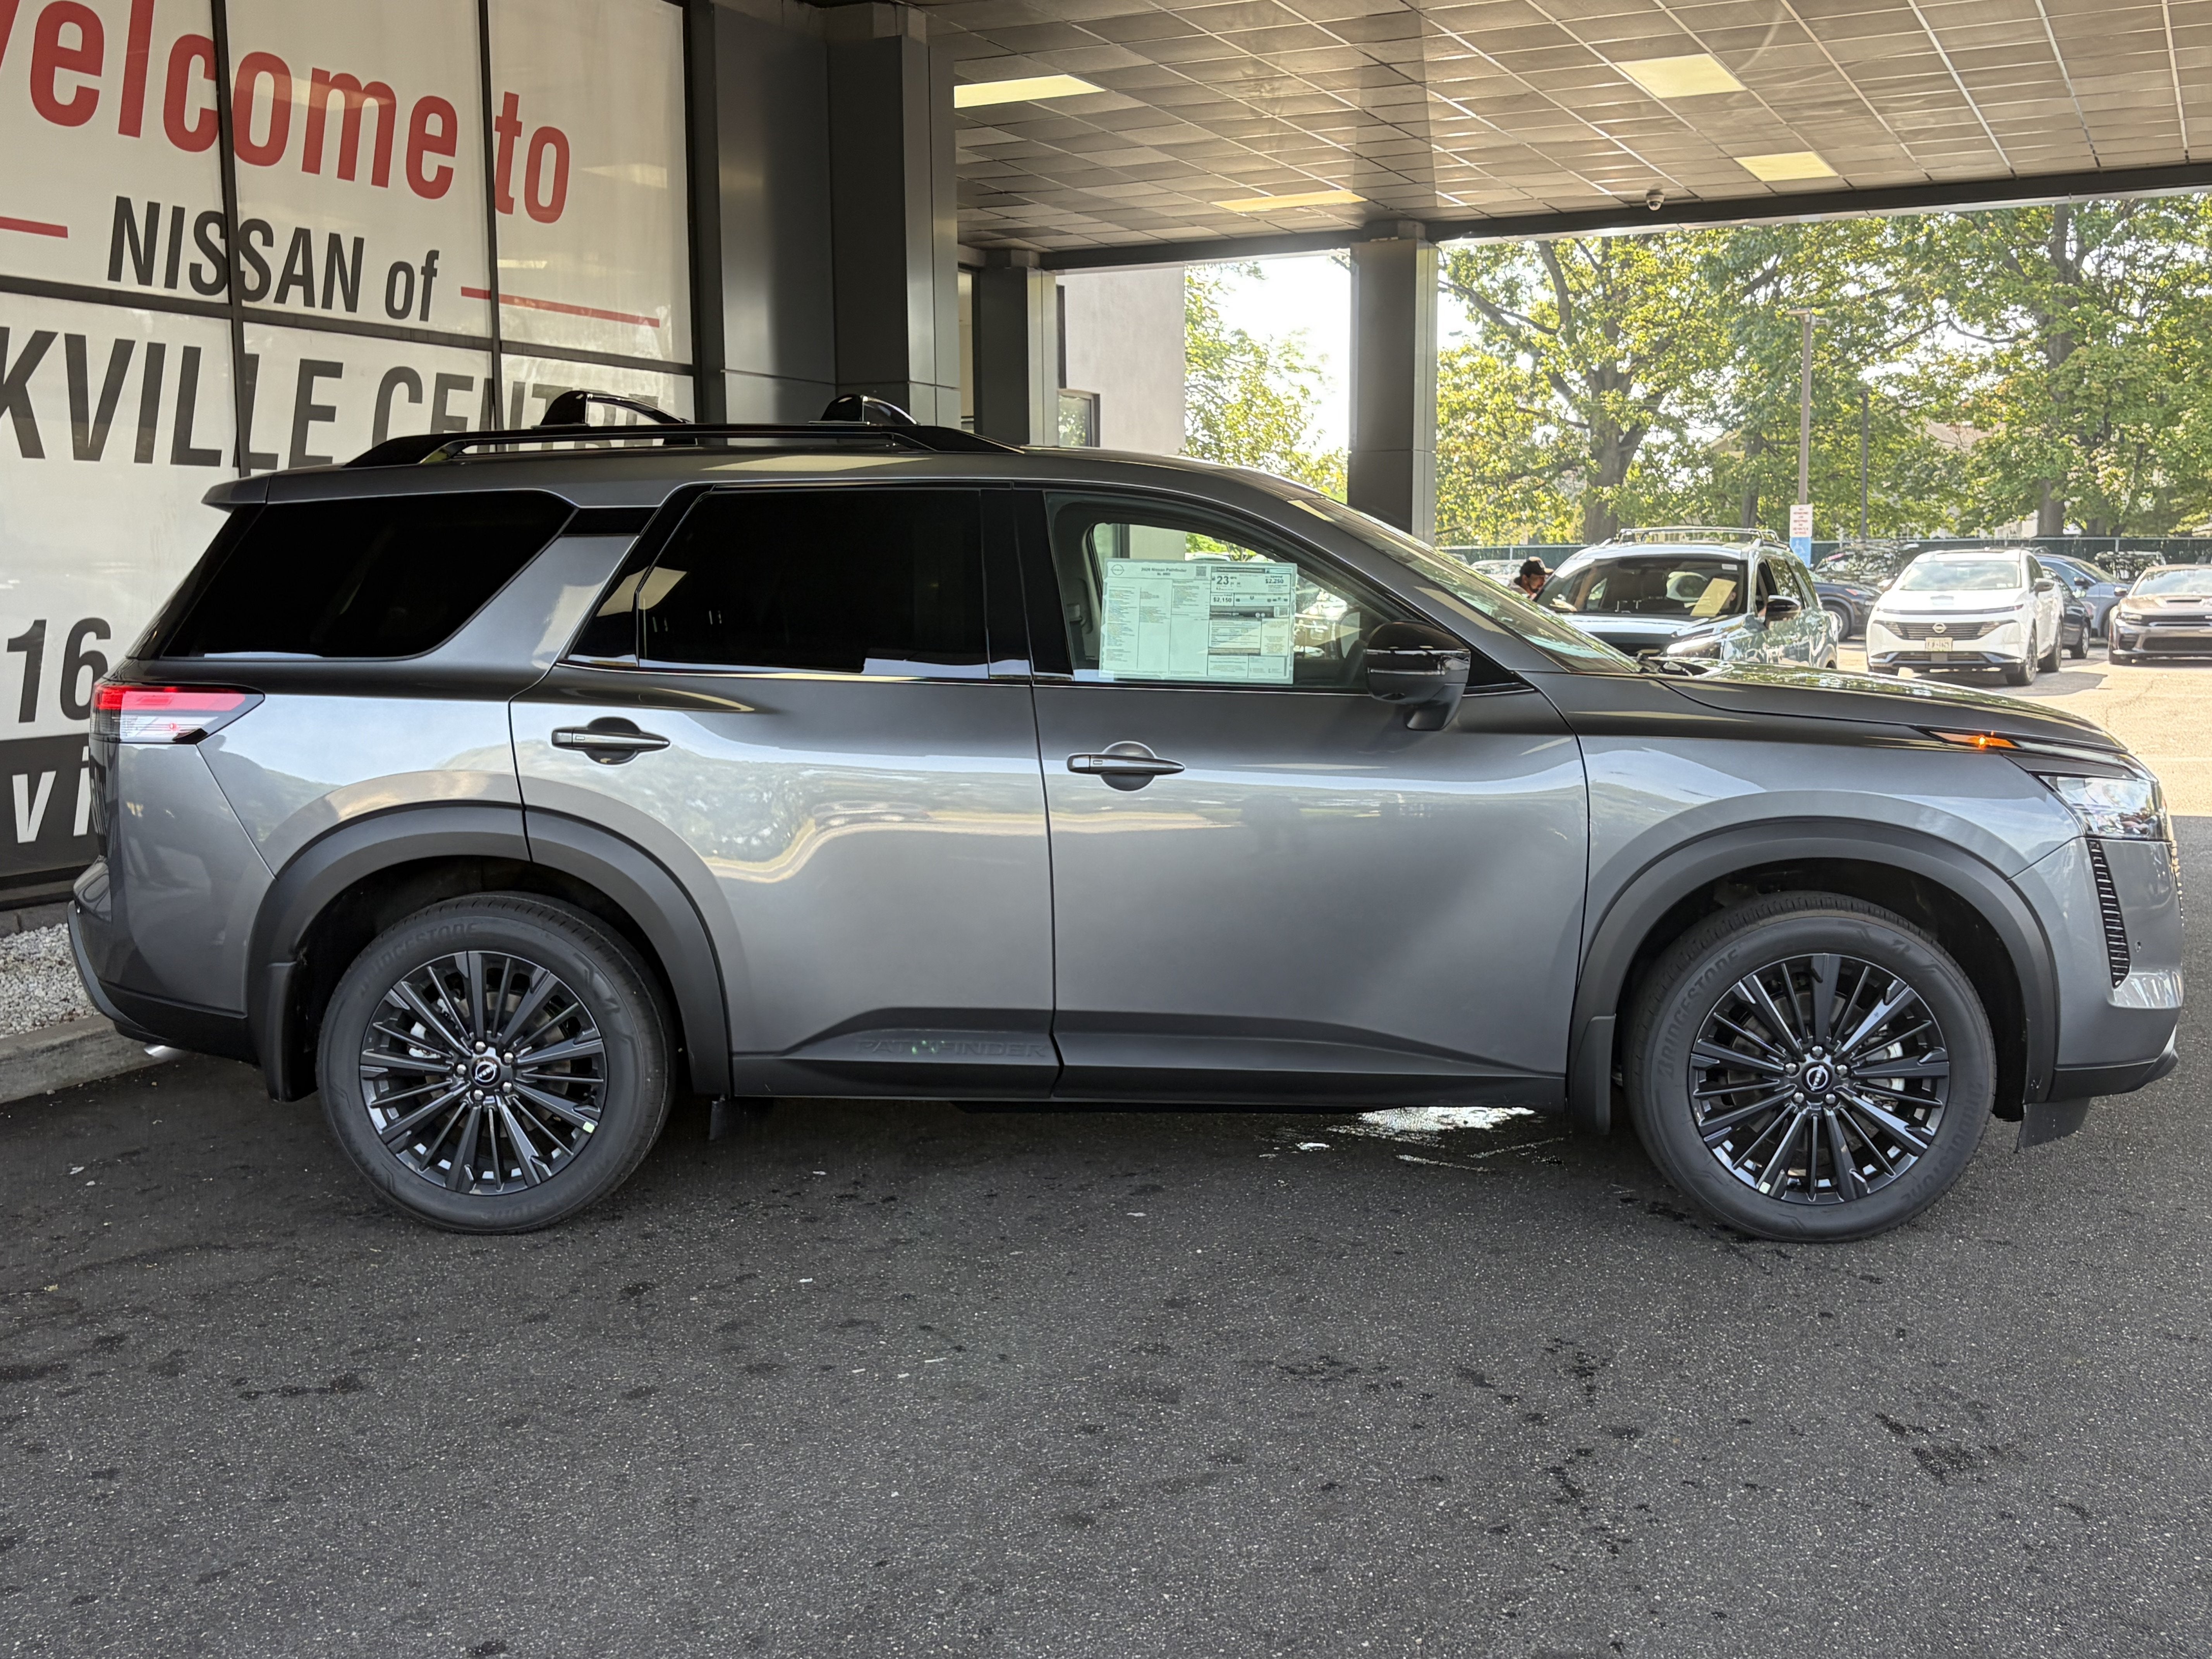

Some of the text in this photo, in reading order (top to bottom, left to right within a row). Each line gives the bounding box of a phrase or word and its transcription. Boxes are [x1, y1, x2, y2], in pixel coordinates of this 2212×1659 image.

[0, 0, 570, 223] elcome to
[108, 196, 439, 321] NISSAN of
[1216, 576, 1229, 585] 23
[7, 617, 111, 723] 16
[358, 922, 479, 998] IDGESTONE
[856, 1039, 1048, 1058] PATHFINDER
[1657, 948, 1739, 1079] BRIDGESTONE
